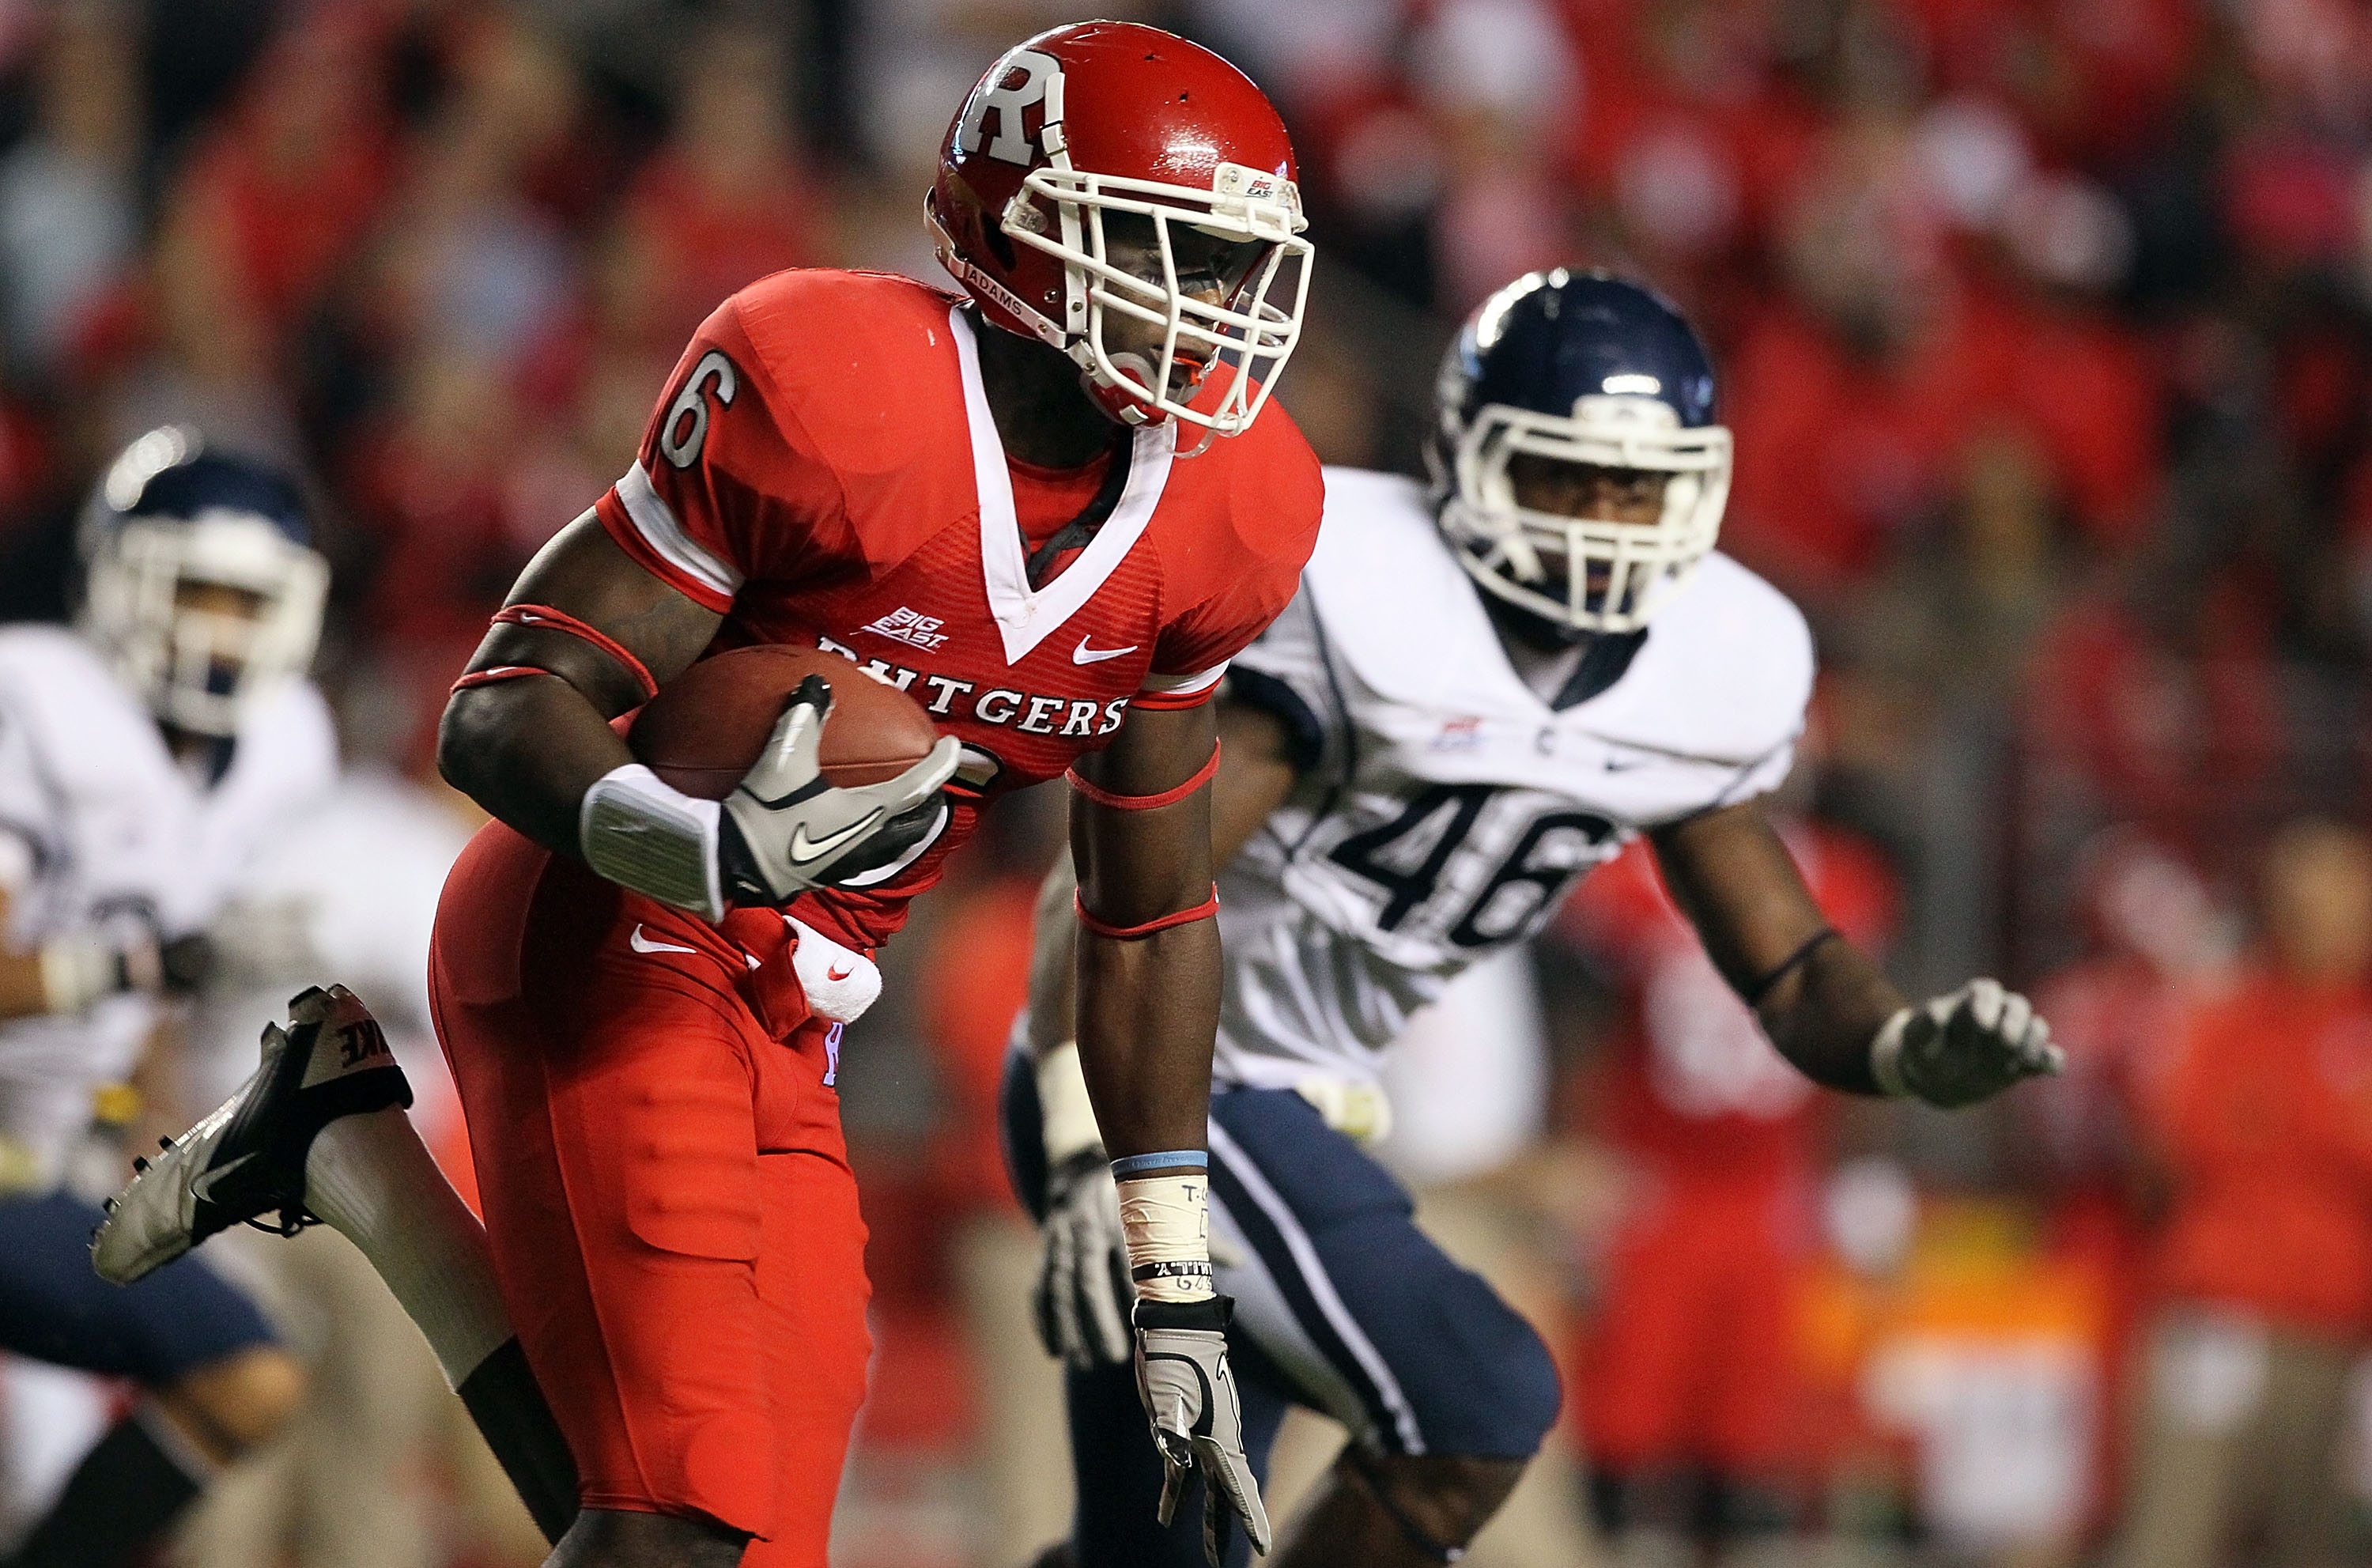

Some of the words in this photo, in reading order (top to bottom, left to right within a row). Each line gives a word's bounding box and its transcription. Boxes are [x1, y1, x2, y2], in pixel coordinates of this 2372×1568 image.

[951, 47, 1060, 167] R
[1246, 187, 1273, 198] EAST
[1251, 179, 1271, 190] BIG
[969, 270, 1022, 315] ADAMS
[660, 351, 736, 468] 6
[871, 615, 950, 648] EAST
[890, 606, 946, 633] BIG
[1326, 784, 1615, 946] 46
[336, 1019, 391, 1068] IKE
